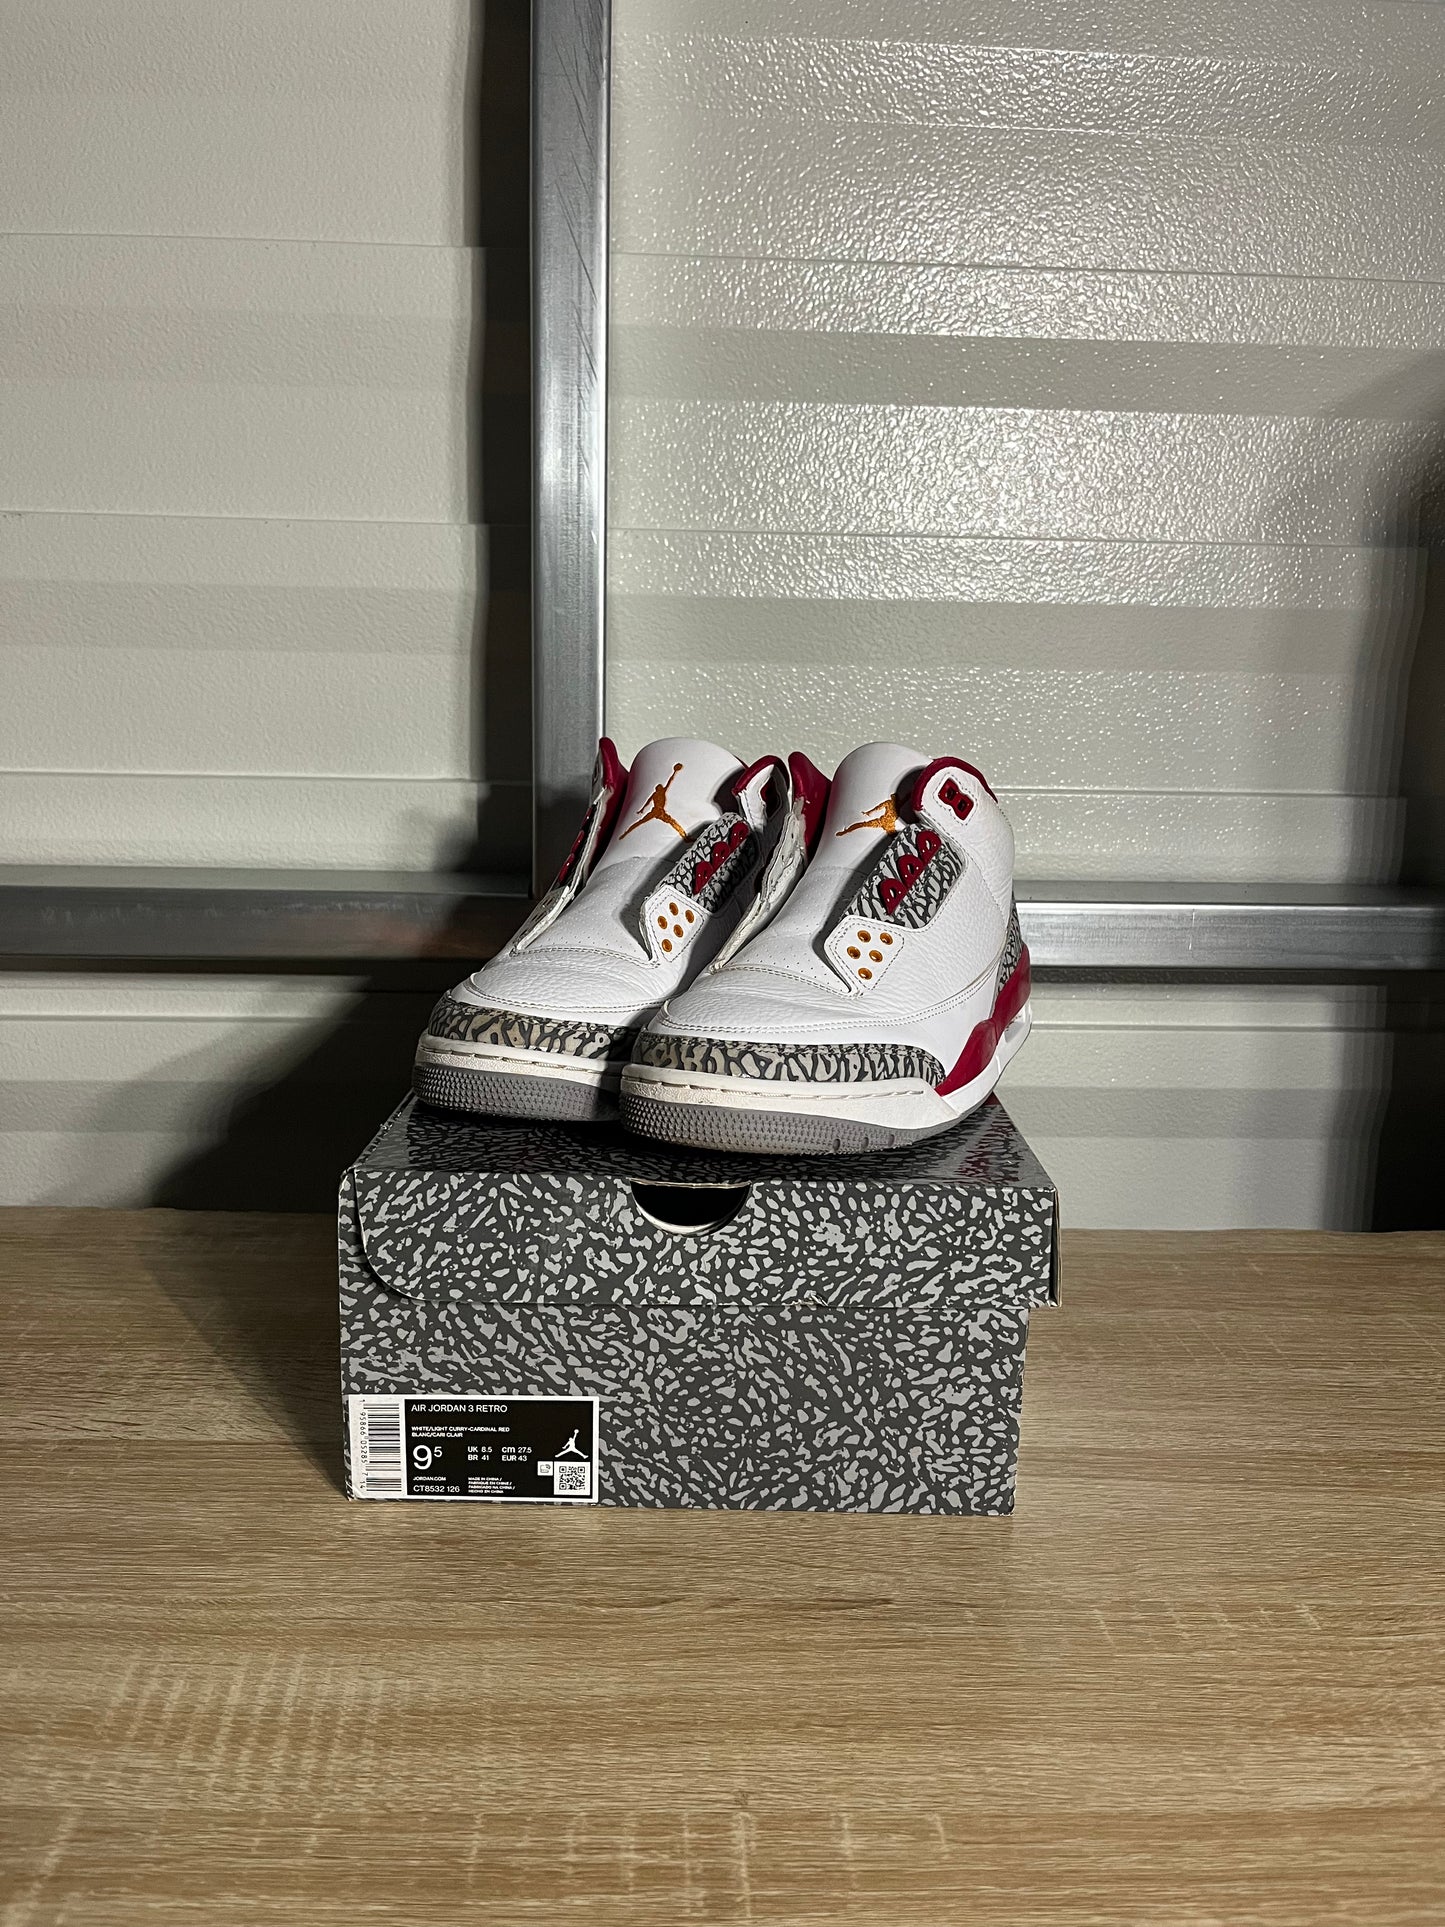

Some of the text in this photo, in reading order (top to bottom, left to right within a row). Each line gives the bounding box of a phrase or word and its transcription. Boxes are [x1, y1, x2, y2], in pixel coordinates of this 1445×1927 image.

[411, 1404, 507, 1413] AIR JORDAN 3 RETRO
[518, 1446, 532, 1454] 27.5
[468, 1454, 478, 1462] BR
[481, 1454, 489, 1462] 41
[413, 1485, 460, 1494] CT8532 126
